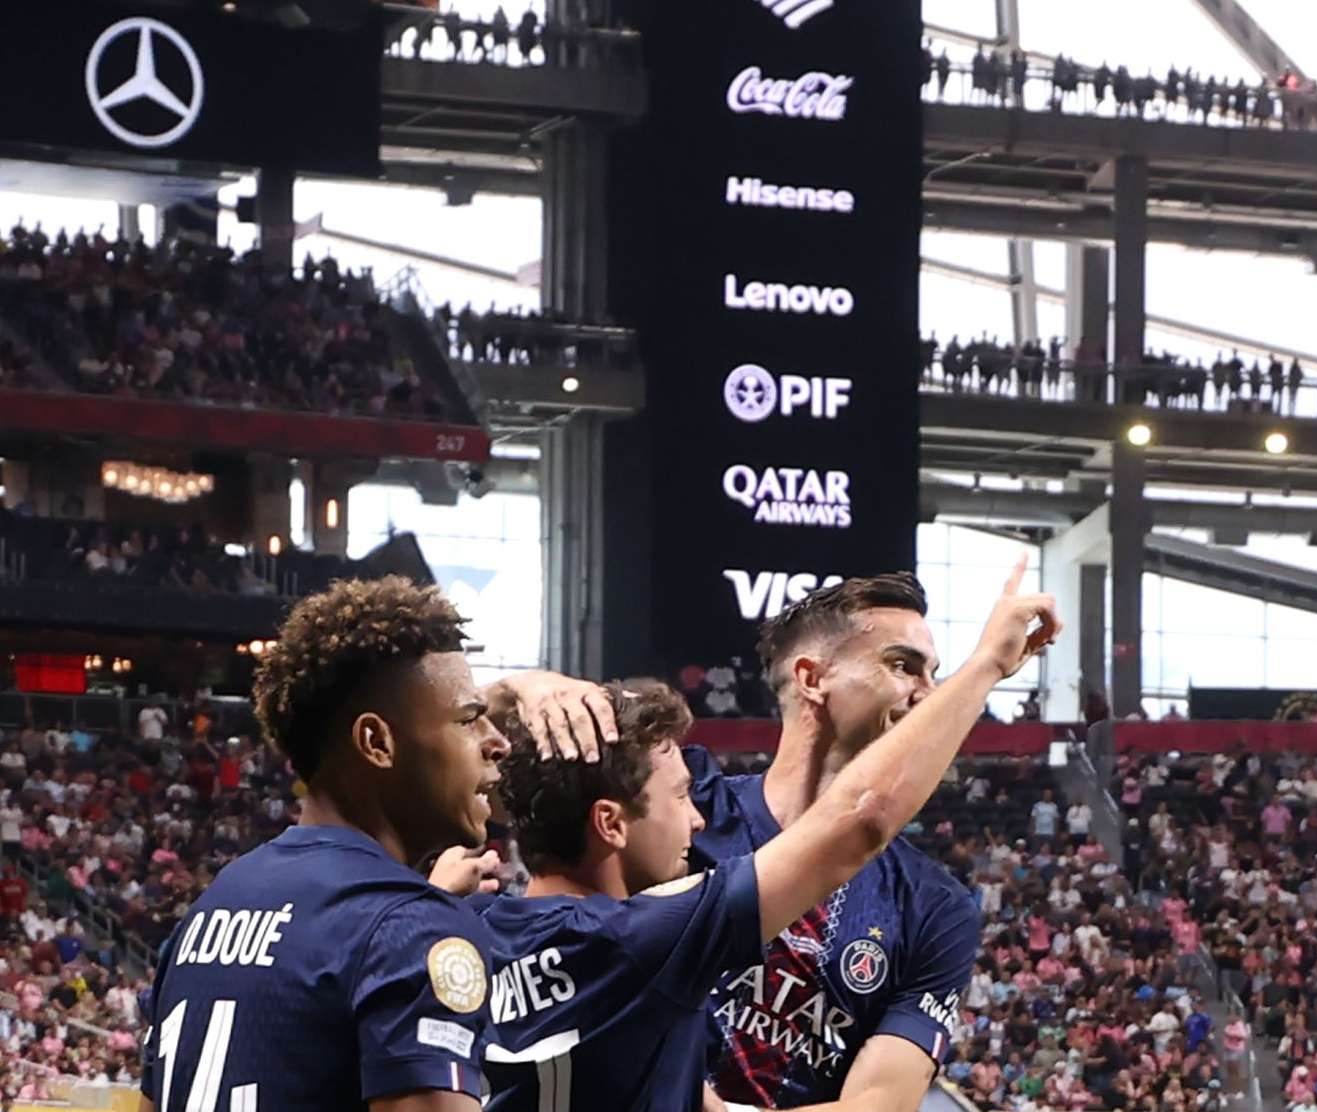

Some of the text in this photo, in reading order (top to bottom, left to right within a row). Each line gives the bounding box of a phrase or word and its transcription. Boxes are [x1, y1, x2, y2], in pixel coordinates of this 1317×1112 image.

[727, 65, 855, 119] Coca-Cola
[725, 175, 855, 212] Hisense
[724, 273, 854, 316] Lenovo
[780, 374, 853, 419] PIF
[722, 463, 851, 508] QATAR
[754, 500, 852, 528] AIRWAYS
[710, 964, 853, 1050] ATAR
